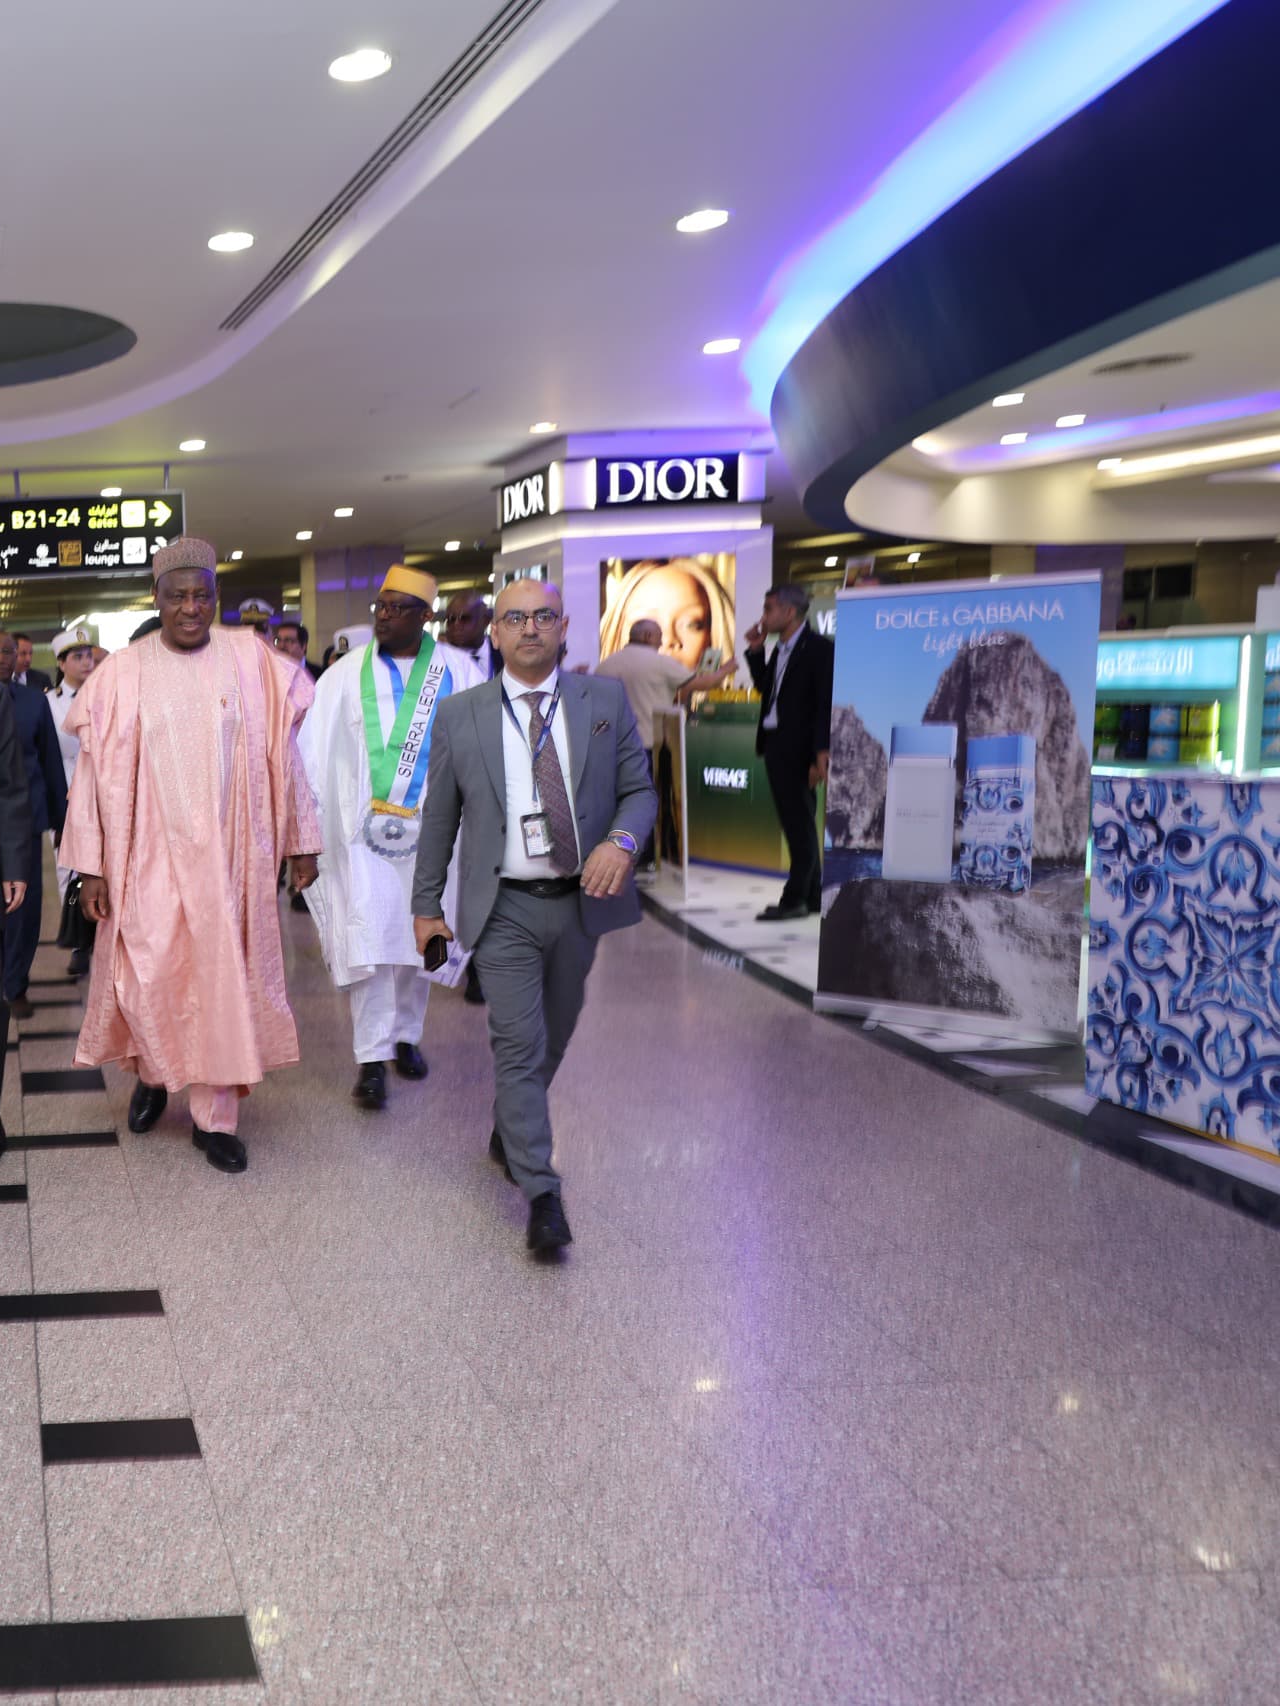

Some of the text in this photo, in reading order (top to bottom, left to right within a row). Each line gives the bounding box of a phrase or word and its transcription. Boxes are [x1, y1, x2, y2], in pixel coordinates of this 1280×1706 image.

[607, 457, 729, 503] DIOR
[504, 474, 545, 523] DIOR
[11, 507, 80, 530] B21-24
[88, 516, 118, 530] Gates
[85, 553, 120, 567] lounge
[875, 607, 939, 631] DOLCE
[952, 598, 1065, 627] GABBANA
[923, 627, 1006, 658] light blue
[398, 664, 444, 778] SIERRA LEONE
[704, 767, 748, 789] VERSACE
